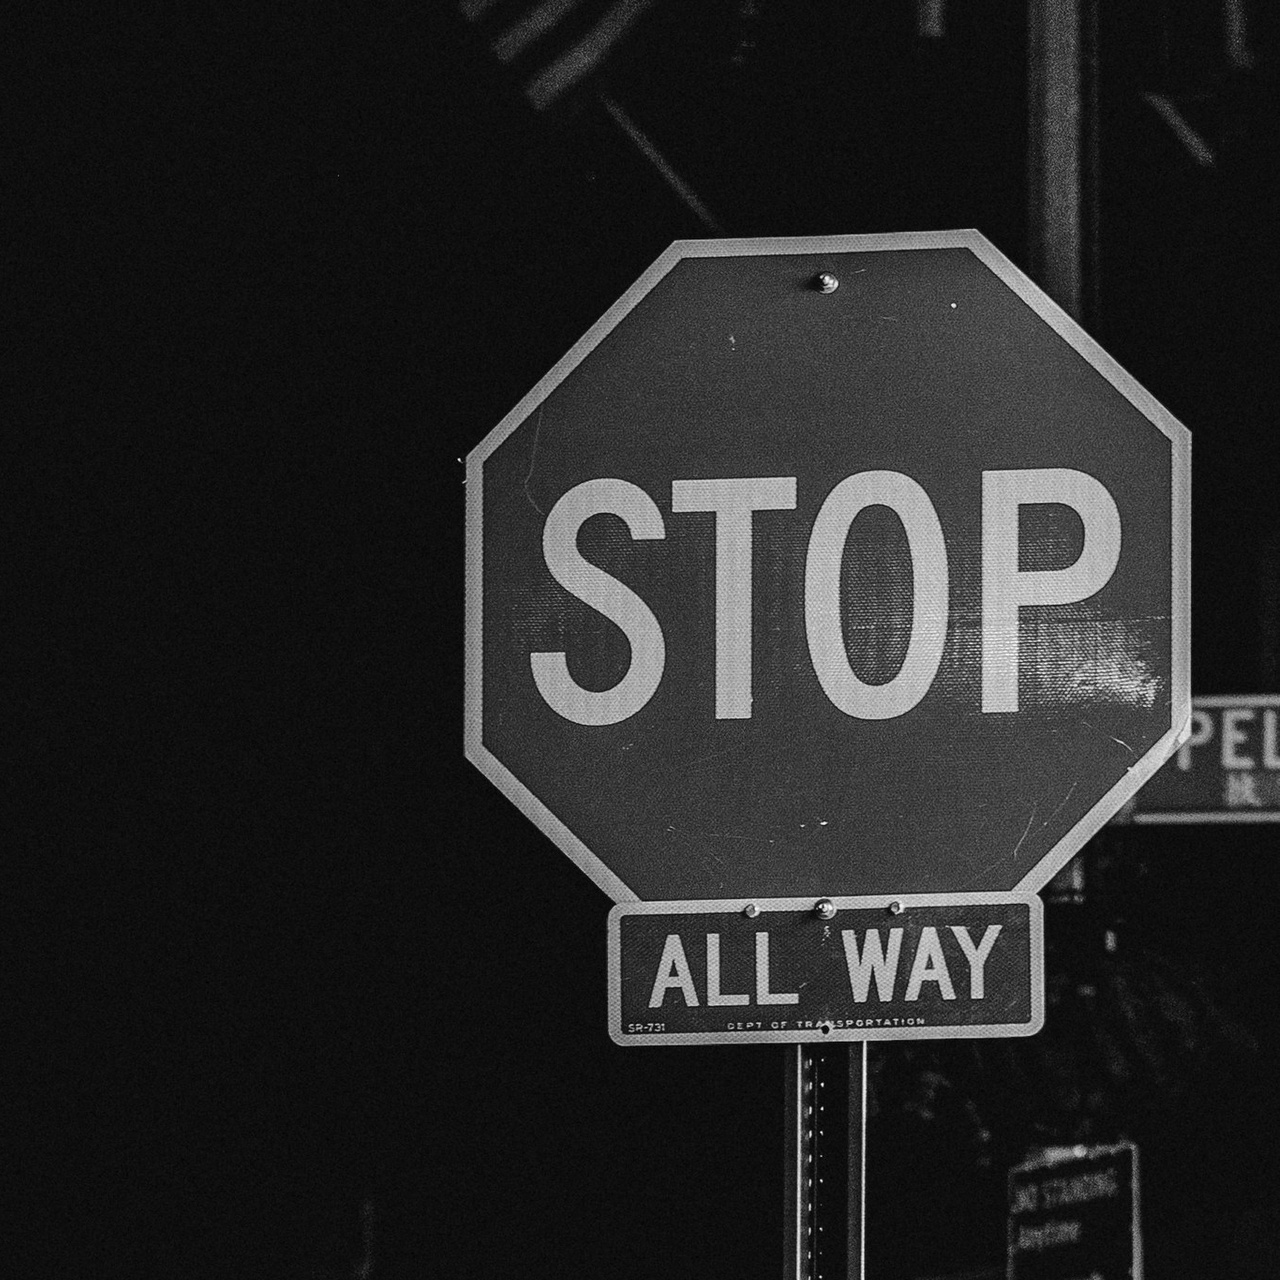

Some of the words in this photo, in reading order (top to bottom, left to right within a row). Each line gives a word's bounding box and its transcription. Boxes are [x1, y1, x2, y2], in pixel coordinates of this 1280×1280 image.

[530, 467, 1123, 726] STOP
[648, 930, 800, 1009] ALL
[841, 924, 1003, 1004] WAY
[627, 1023, 666, 1033] SR-731
[727, 1021, 762, 1030] DEPT
[771, 1020, 788, 1029] OF
